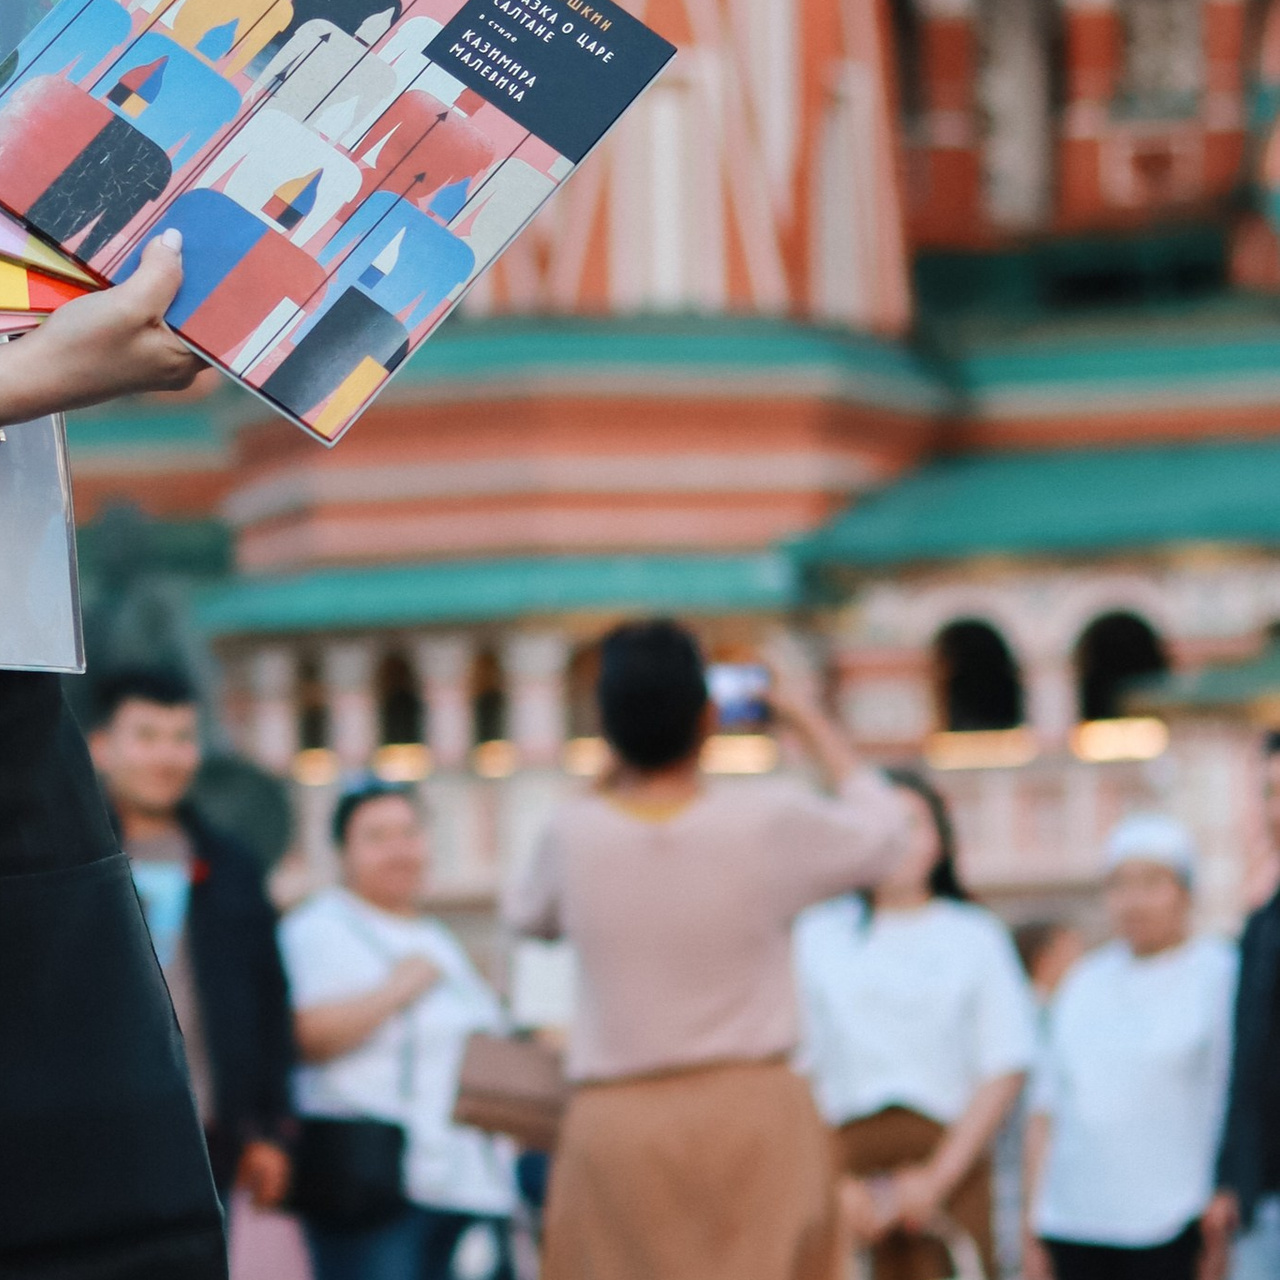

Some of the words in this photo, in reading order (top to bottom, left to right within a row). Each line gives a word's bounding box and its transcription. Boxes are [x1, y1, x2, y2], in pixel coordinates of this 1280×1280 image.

[488, 20, 518, 43] стиле
[562, 22, 574, 34] О
[576, 32, 615, 64] ЦАРЕ
[449, 43, 526, 102] МАЛЕВИЧА
[461, 29, 537, 88] КАЗИМИРА
